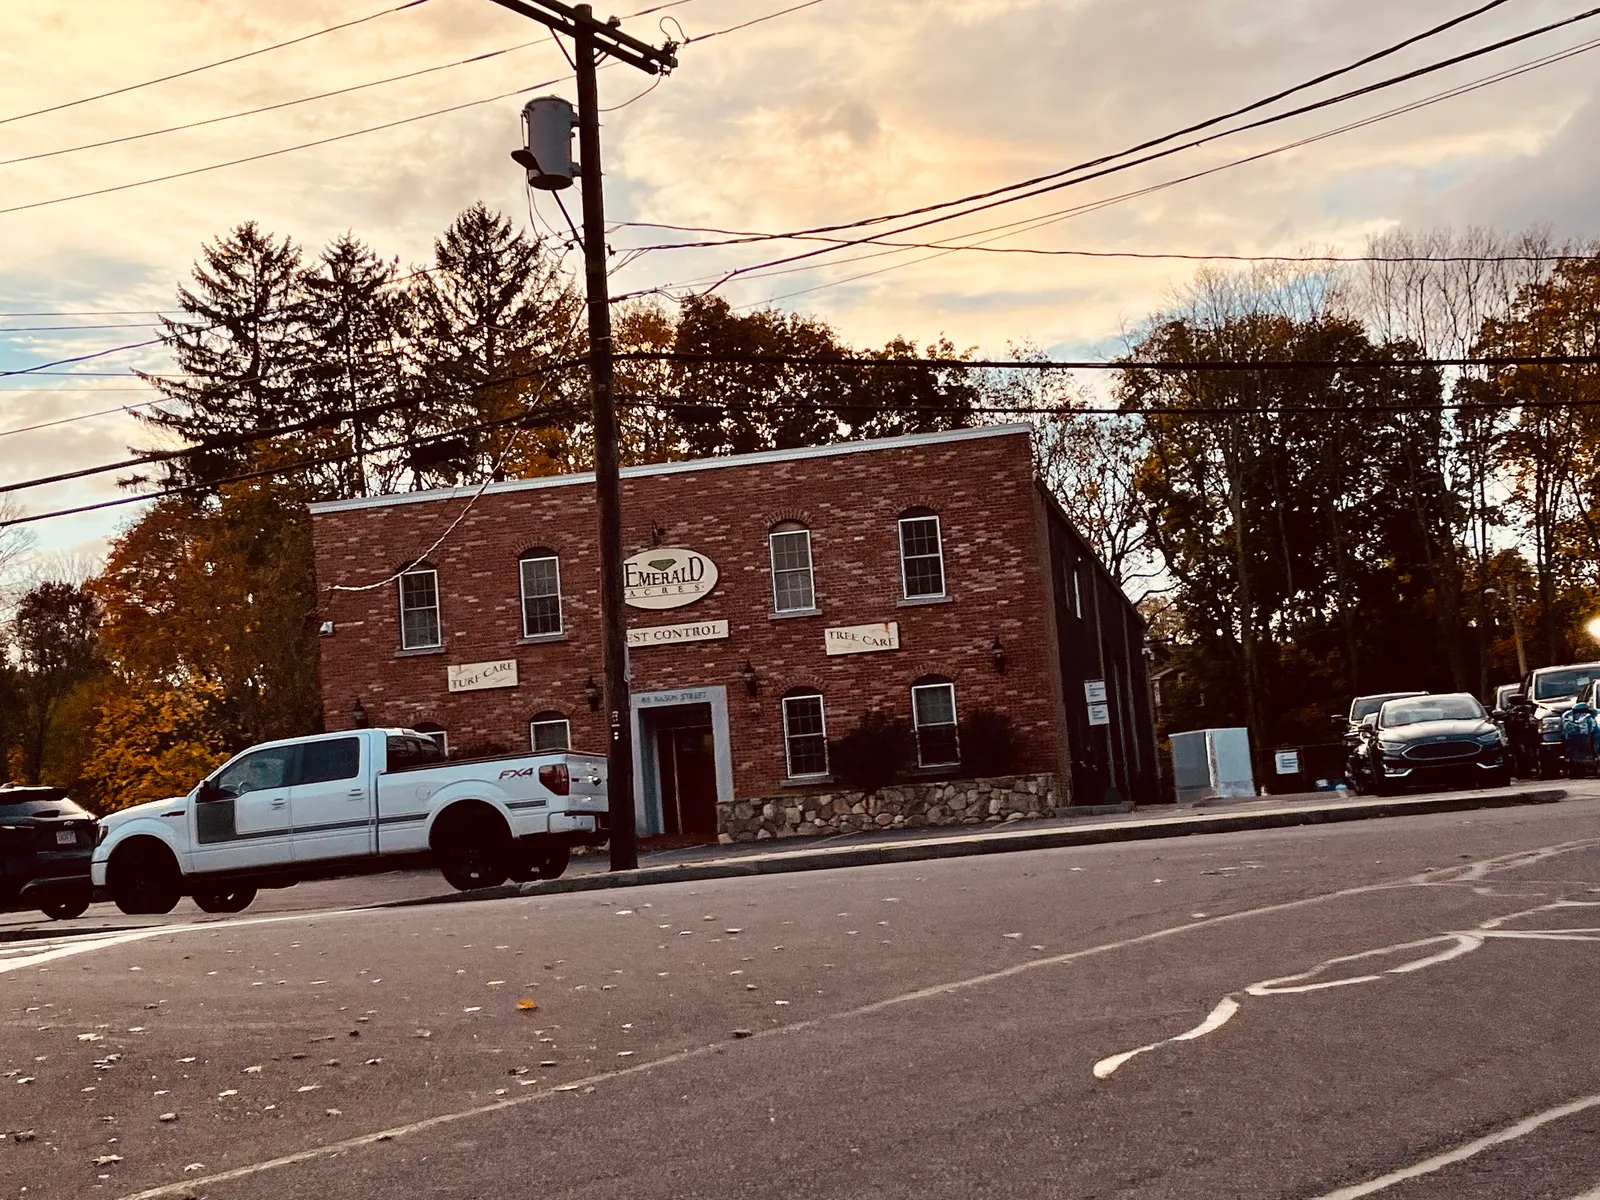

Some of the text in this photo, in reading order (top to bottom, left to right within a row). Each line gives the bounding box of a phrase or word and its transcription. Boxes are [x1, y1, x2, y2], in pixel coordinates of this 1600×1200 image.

[624, 556, 704, 588] EMERALD
[629, 583, 700, 597] ACRES
[627, 625, 720, 643] EST CONTROL
[828, 631, 895, 647] TREE CARE
[451, 662, 514, 689] TURF CARE
[680, 692, 707, 701] STREET
[499, 767, 533, 779] FX4
